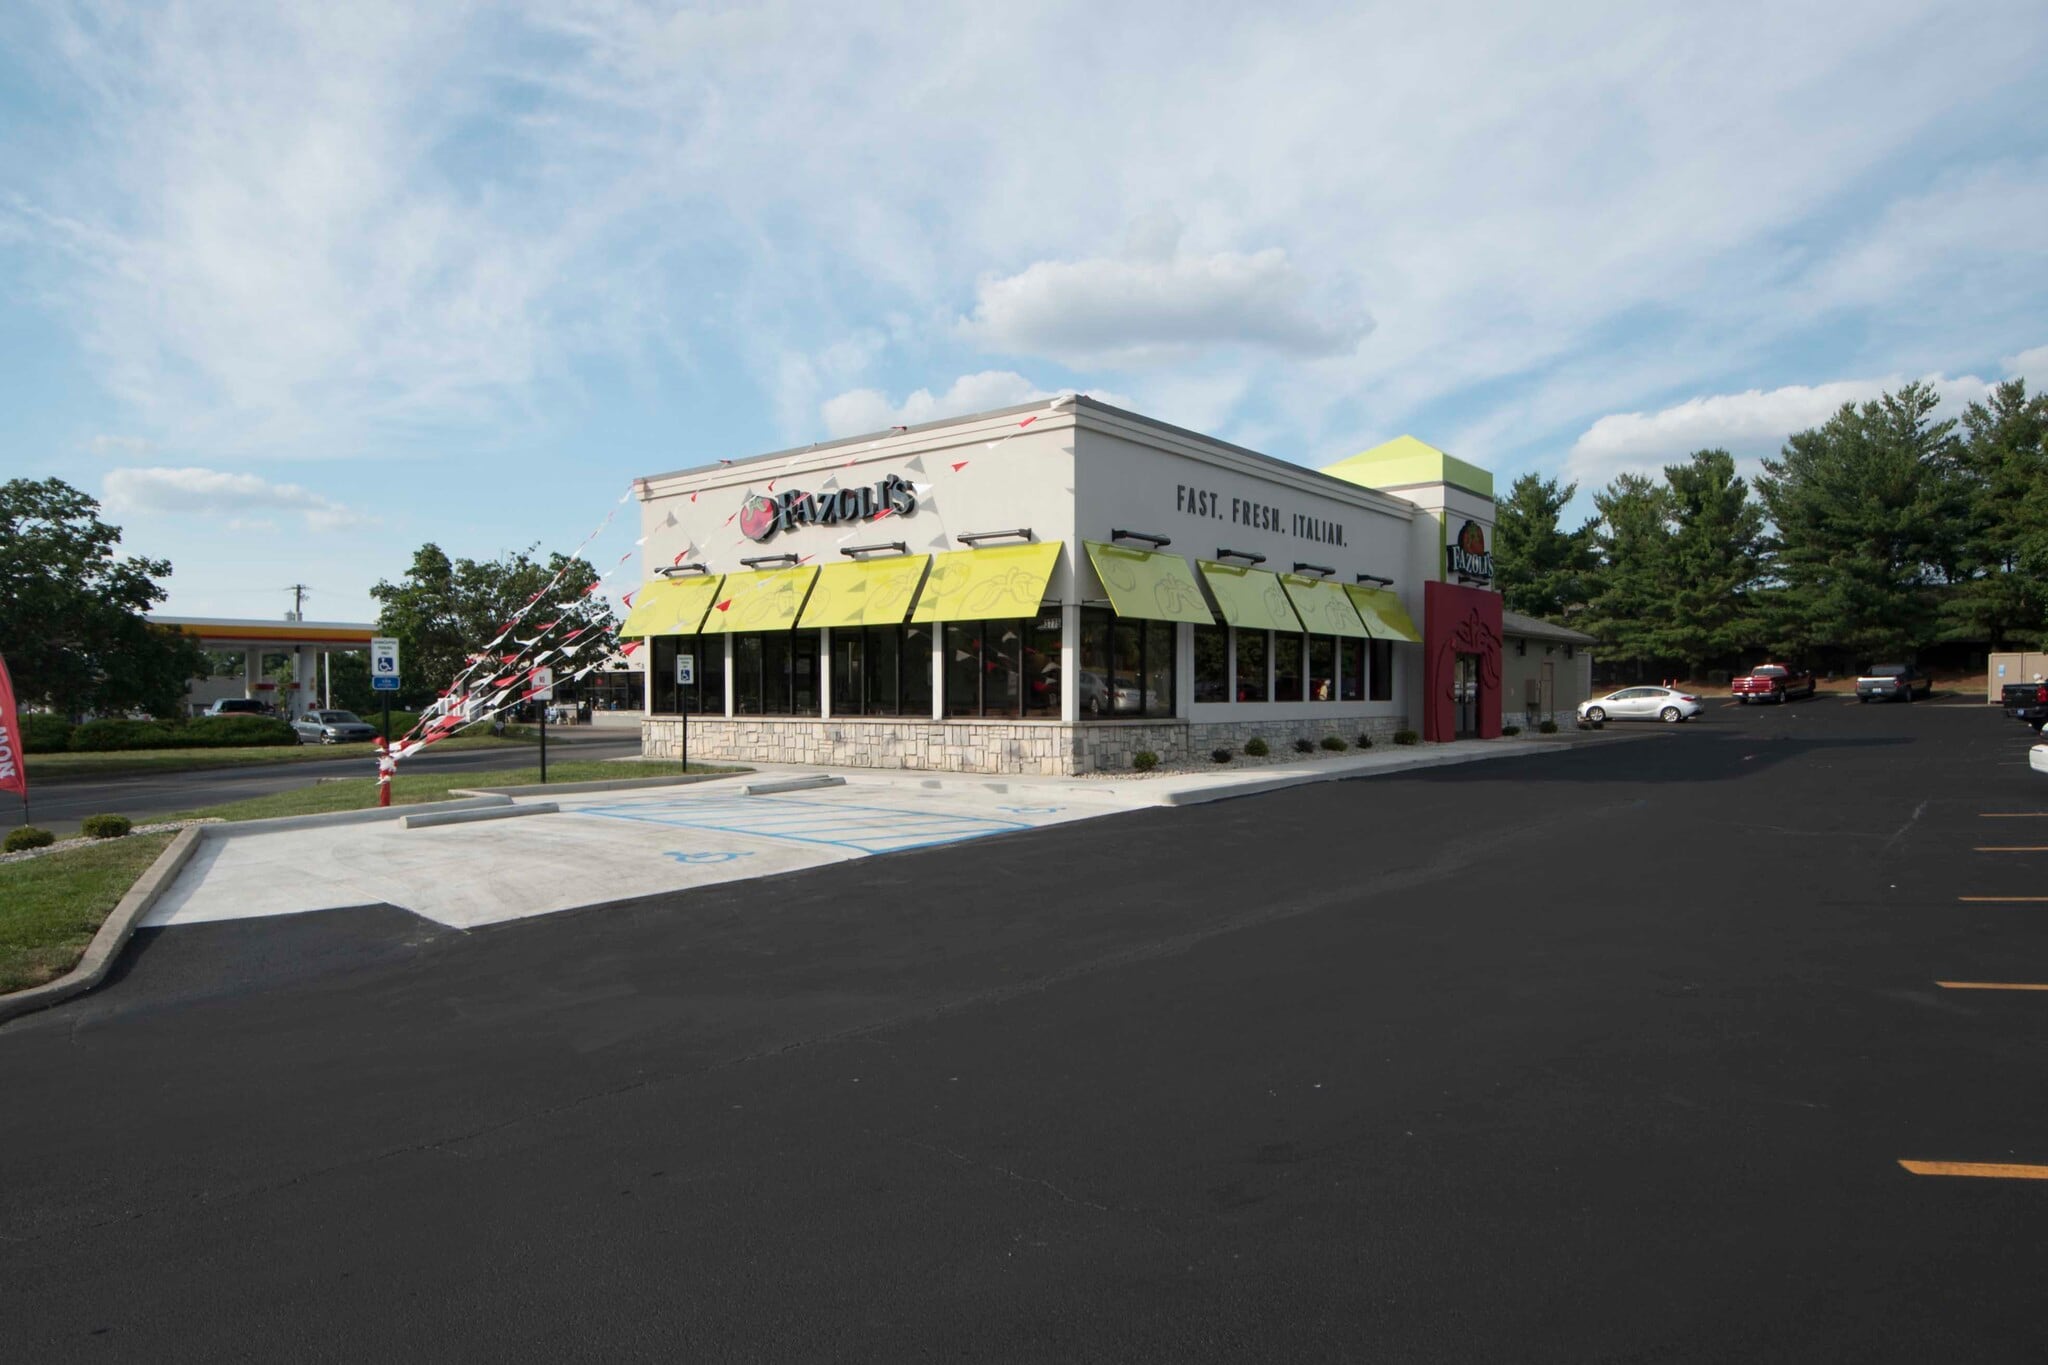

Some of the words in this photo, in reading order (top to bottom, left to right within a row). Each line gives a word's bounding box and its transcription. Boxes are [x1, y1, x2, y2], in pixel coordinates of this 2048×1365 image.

[775, 473, 917, 530] FAZOLI'S
[1177, 484, 1223, 521] FAST.
[1232, 497, 1286, 534] FRESH.
[1293, 513, 1348, 548] ITALIAN.
[1452, 545, 1494, 577] FAZOLI'S
